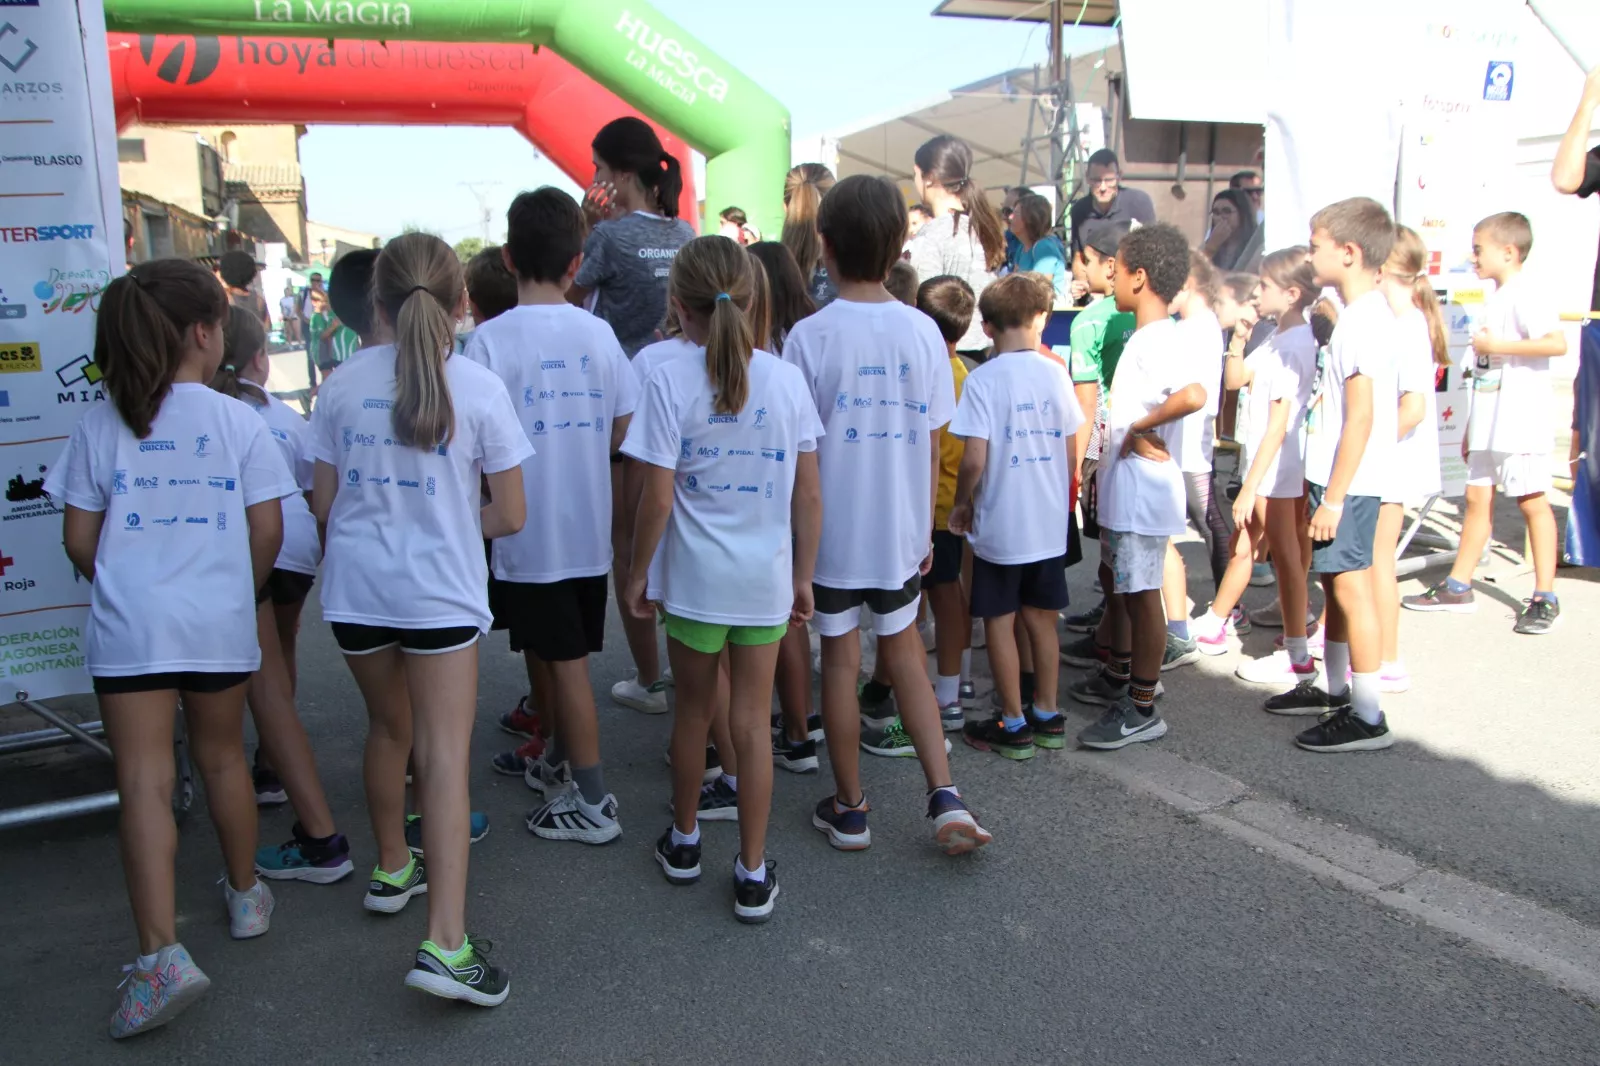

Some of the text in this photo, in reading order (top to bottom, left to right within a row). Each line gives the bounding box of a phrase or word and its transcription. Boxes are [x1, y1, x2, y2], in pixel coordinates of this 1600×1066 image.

[236, 36, 337, 74] hoya
[34, 155, 83, 166] BLASCO
[707, 416, 738, 425] QUICENA
[139, 443, 176, 453] QUICENA
[11, 503, 42, 513] AMIGOS
[5, 577, 36, 592] Roja
[0, 626, 80, 646] DERACIÓN
